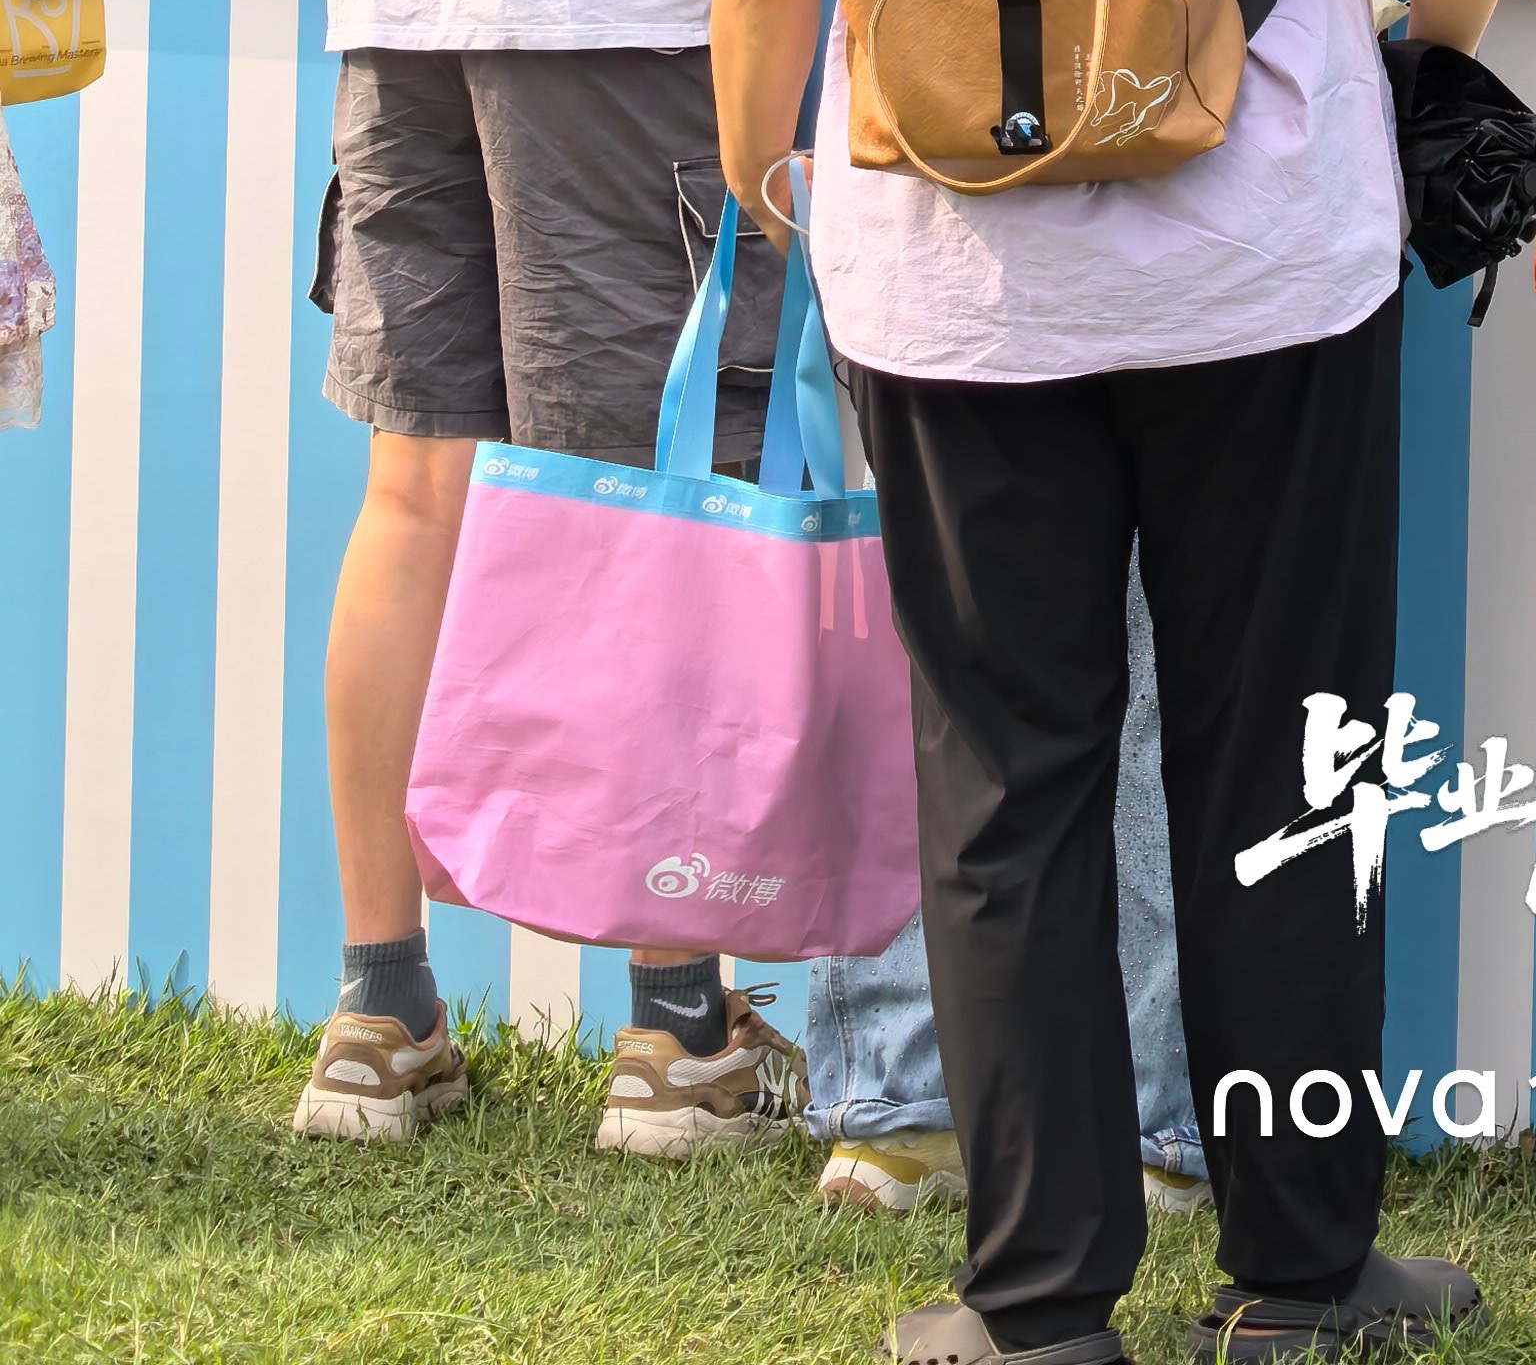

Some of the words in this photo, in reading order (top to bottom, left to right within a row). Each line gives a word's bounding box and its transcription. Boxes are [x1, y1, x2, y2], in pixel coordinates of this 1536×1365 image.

[507, 464, 540, 481] 微博
[615, 482, 648, 500] 微博
[705, 871, 786, 906] 微博
[340, 1023, 383, 1044] YANKEES
